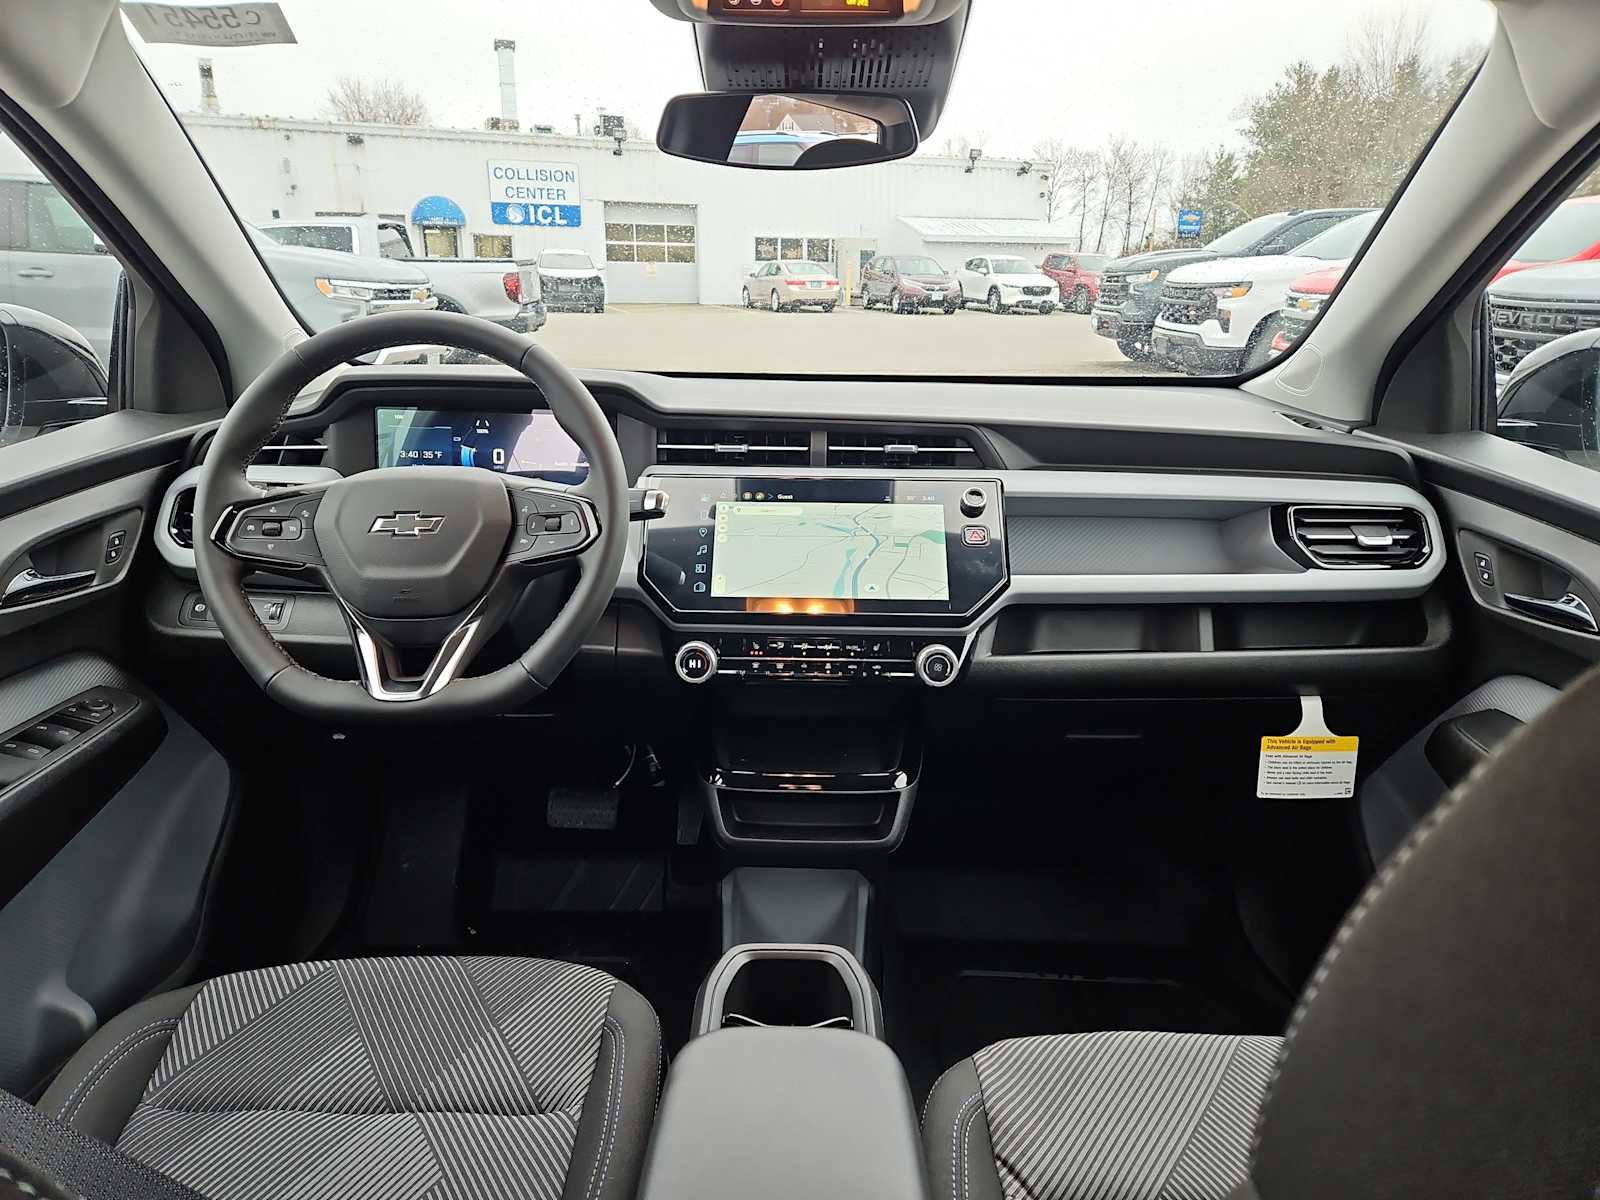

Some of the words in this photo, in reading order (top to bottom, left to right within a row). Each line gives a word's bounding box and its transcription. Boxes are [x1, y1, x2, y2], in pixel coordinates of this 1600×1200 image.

[493, 166, 576, 183] COLLISION
[505, 186, 567, 201] CENTER
[529, 205, 569, 225] ICL
[400, 450, 419, 458] 3:40
[422, 451, 434, 459] 35
[492, 448, 505, 465] 0
[689, 660, 701, 669] HI
